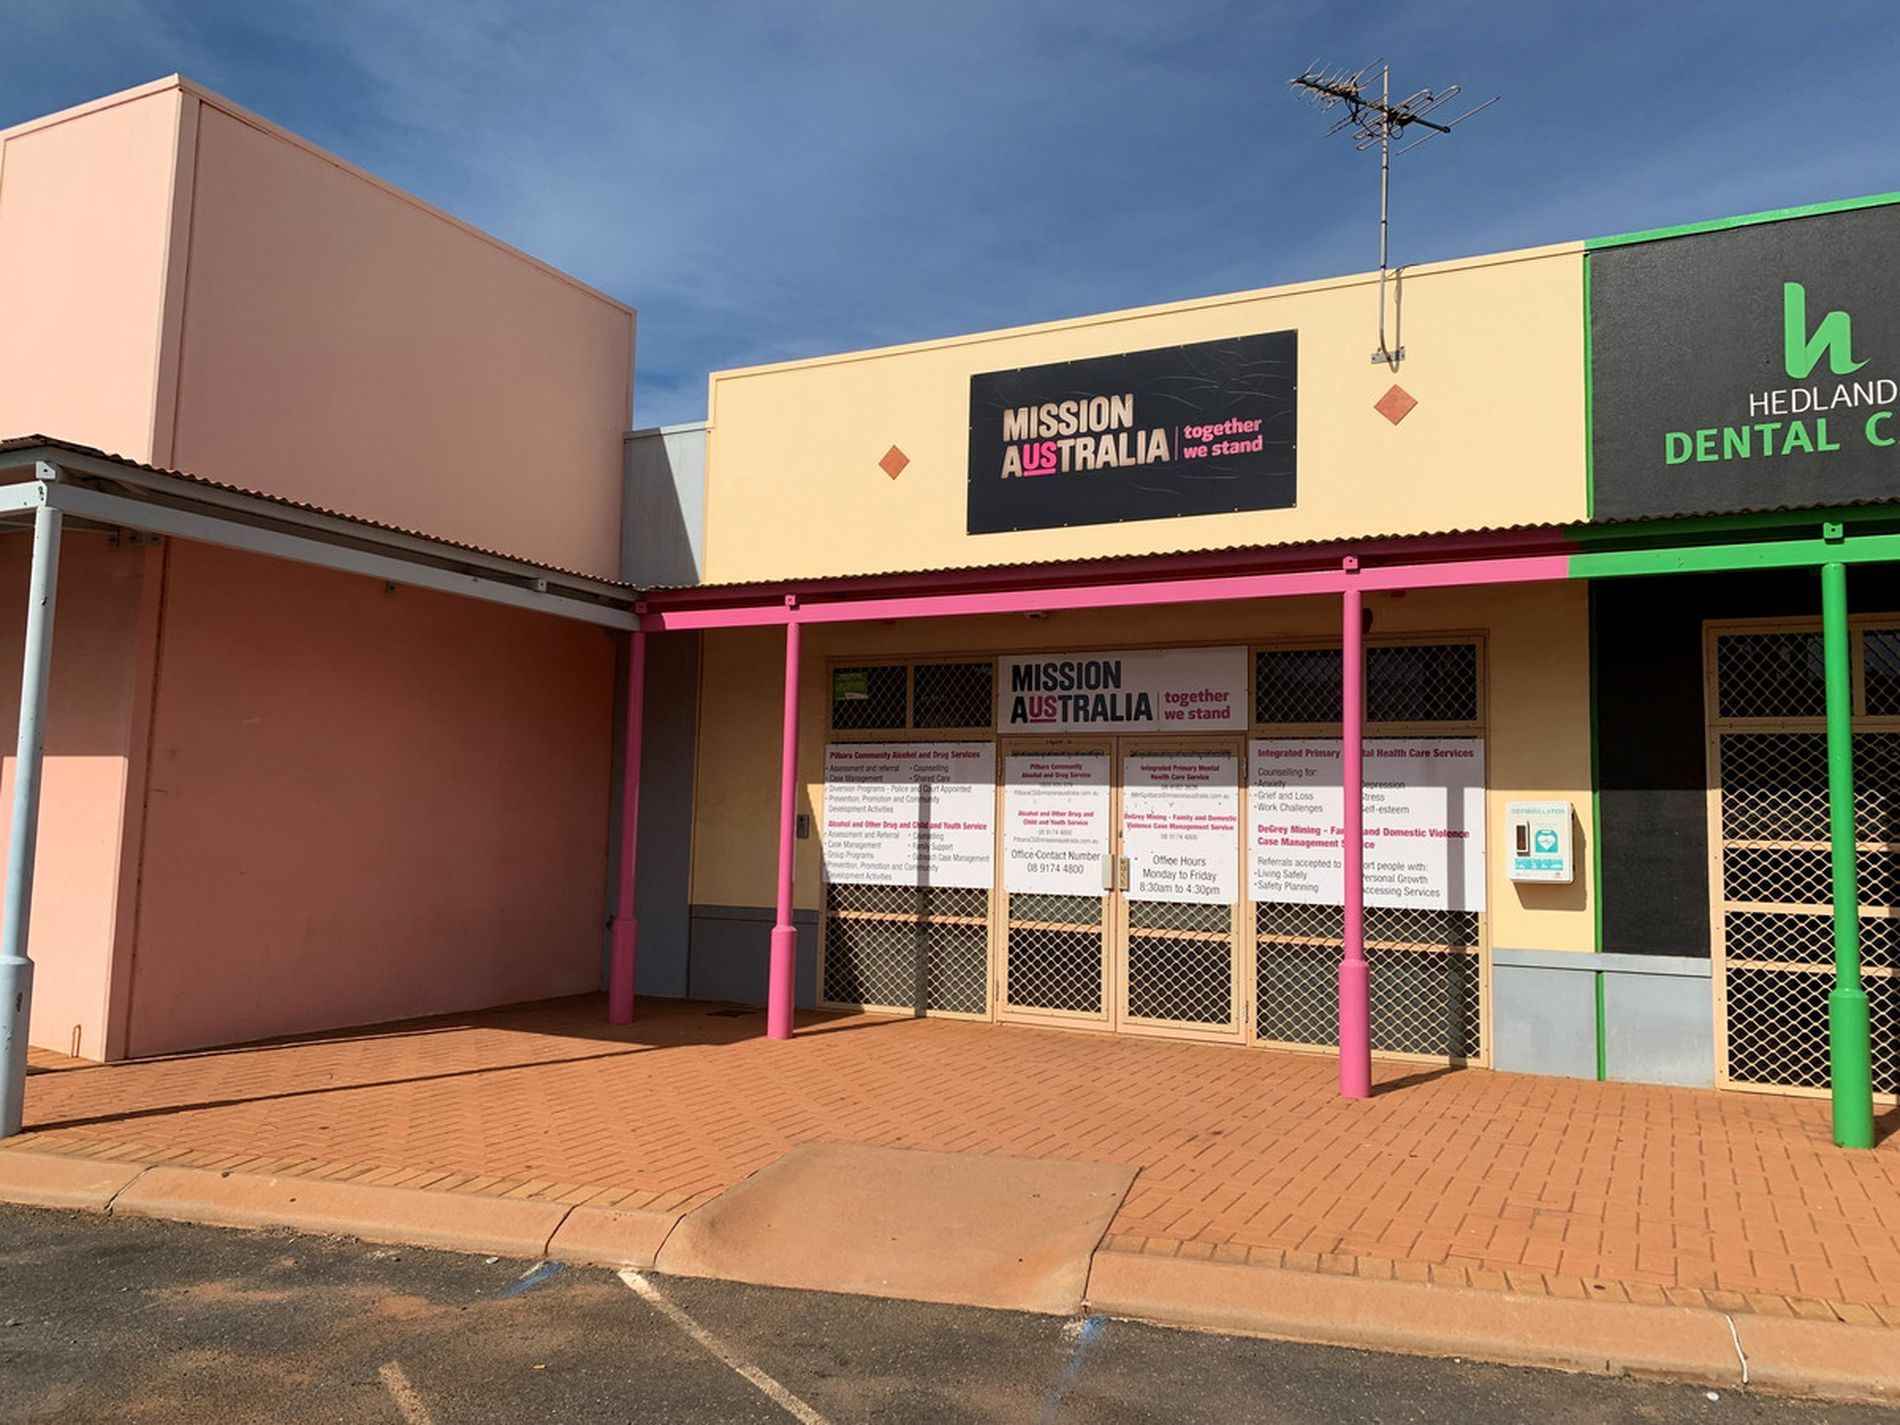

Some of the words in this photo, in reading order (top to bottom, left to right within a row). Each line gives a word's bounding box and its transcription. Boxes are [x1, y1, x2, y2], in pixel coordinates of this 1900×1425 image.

[1750, 379, 1898, 417] HEDLAND
[1003, 393, 1134, 442] MISSION
[1184, 417, 1262, 442] together
[1665, 417, 1840, 465] DENTAL
[1864, 411, 1900, 447] C
[1183, 443, 1208, 460] we
[1211, 434, 1264, 457] stand
[1001, 428, 1170, 479] AUSTRALIA
[1012, 660, 1122, 692] MISSION
[1164, 689, 1229, 707] together
[1010, 692, 1153, 724] AUSTRALIA
[1164, 709, 1184, 720] we
[1188, 706, 1231, 720] stand
[854, 752, 891, 760] Community
[892, 751, 918, 759] Alcohol
[918, 751, 931, 759] and
[933, 751, 949, 760] Drug
[951, 751, 980, 759] Services
[1257, 748, 1303, 758] Integrated
[1305, 748, 1341, 759] Primary
[1377, 748, 1406, 757] Health
[1408, 748, 1431, 757] Care
[1433, 748, 1474, 757] Services
[913, 764, 949, 773] Counselling
[1257, 767, 1303, 778] Counselling
[845, 775, 883, 783] Management
[1257, 780, 1286, 788] Anxiety
[857, 785, 885, 794] Programs
[910, 785, 922, 793] and
[940, 785, 972, 794] Appointed
[1362, 781, 1405, 790] epression
[862, 795, 890, 803] Promotion
[892, 795, 904, 803] and
[1257, 791, 1277, 800] Grief
[1279, 791, 1293, 800] and
[1295, 792, 1314, 800] Loss
[829, 805, 866, 813] Development
[867, 805, 894, 813] Activities
[1257, 803, 1279, 812] Work
[1280, 803, 1324, 813] Challenges
[1146, 813, 1167, 821] Mining
[883, 821, 897, 830] Drug
[900, 821, 910, 829] and
[943, 822, 961, 830] Youth
[963, 822, 987, 830] Service
[1169, 823, 1209, 831] Management
[828, 831, 863, 839] Assessment
[1257, 824, 1288, 835] DeGrey
[1290, 824, 1321, 835] Mining
[1383, 828, 1427, 837] Domestic
[1429, 828, 1470, 838] Violence
[843, 841, 882, 850] Management
[1257, 837, 1279, 846] Case
[1280, 838, 1339, 849] Management
[846, 852, 874, 860] Programs
[953, 854, 990, 863] Management
[1011, 850, 1034, 859] Office
[1035, 850, 1066, 860] Contact
[1068, 851, 1100, 861] Number
[1153, 854, 1178, 866] Office
[1180, 856, 1207, 867] Hours
[860, 862, 890, 870] Promotion
[1257, 856, 1293, 866] Referrals
[1294, 859, 1331, 869] accepted
[1333, 860, 1342, 868] to
[1377, 862, 1405, 871] people
[1027, 863, 1038, 873] 08
[1040, 863, 1061, 873] 9174
[1062, 864, 1084, 874] 4800
[865, 872, 892, 881] Activities
[1142, 868, 1177, 880] Monday
[1179, 869, 1188, 880] to
[1190, 870, 1217, 883] Friday
[1257, 869, 1281, 879] Living
[1282, 869, 1308, 880] Safely
[1397, 874, 1429, 884] Growth
[1174, 883, 1184, 893] to
[1257, 880, 1282, 891] Safety
[1284, 881, 1319, 893] Planning
[1403, 887, 1441, 898] Services
